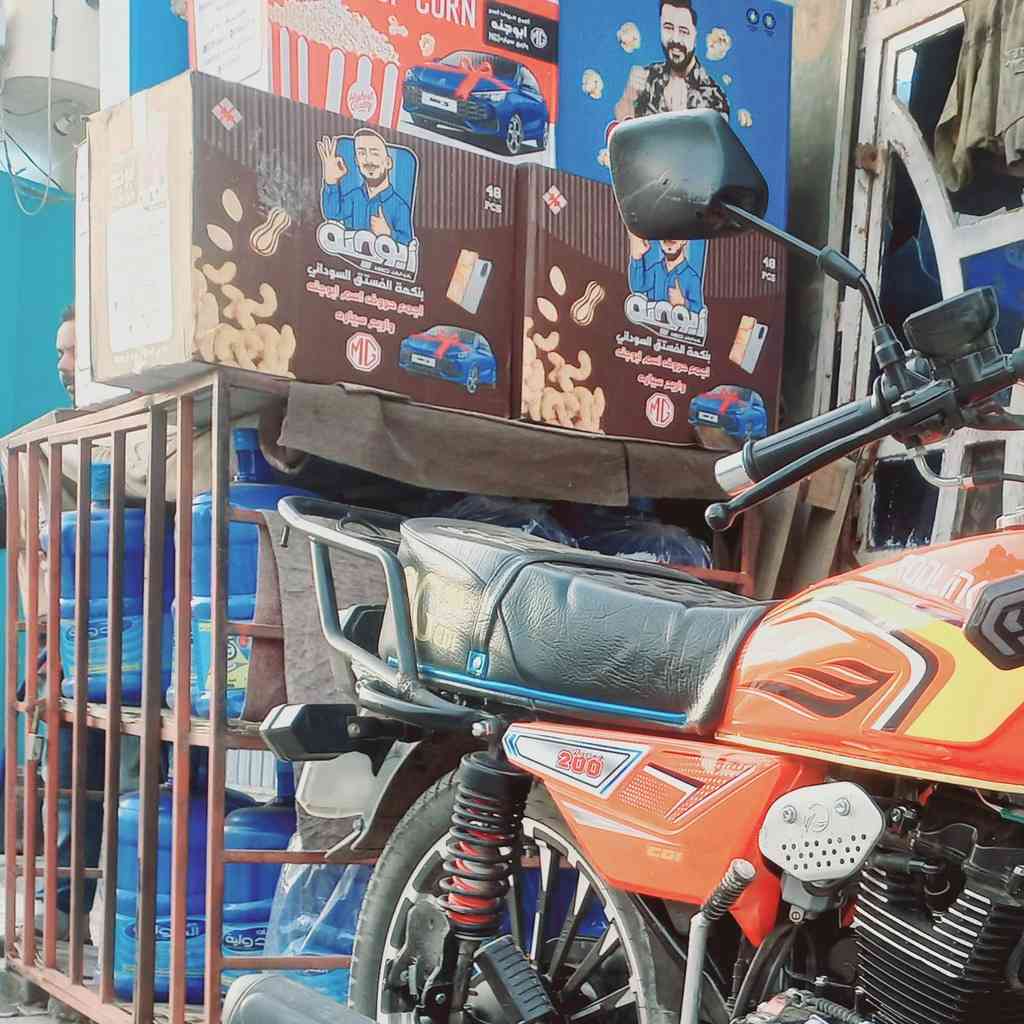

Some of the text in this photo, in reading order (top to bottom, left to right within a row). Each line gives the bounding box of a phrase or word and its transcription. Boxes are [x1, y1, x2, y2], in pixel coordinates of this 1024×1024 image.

[486, 184, 501, 199] 48
[762, 256, 776, 269] 48
[346, 331, 382, 372] MG
[645, 392, 675, 428] MG
[557, 750, 604, 778] 200
